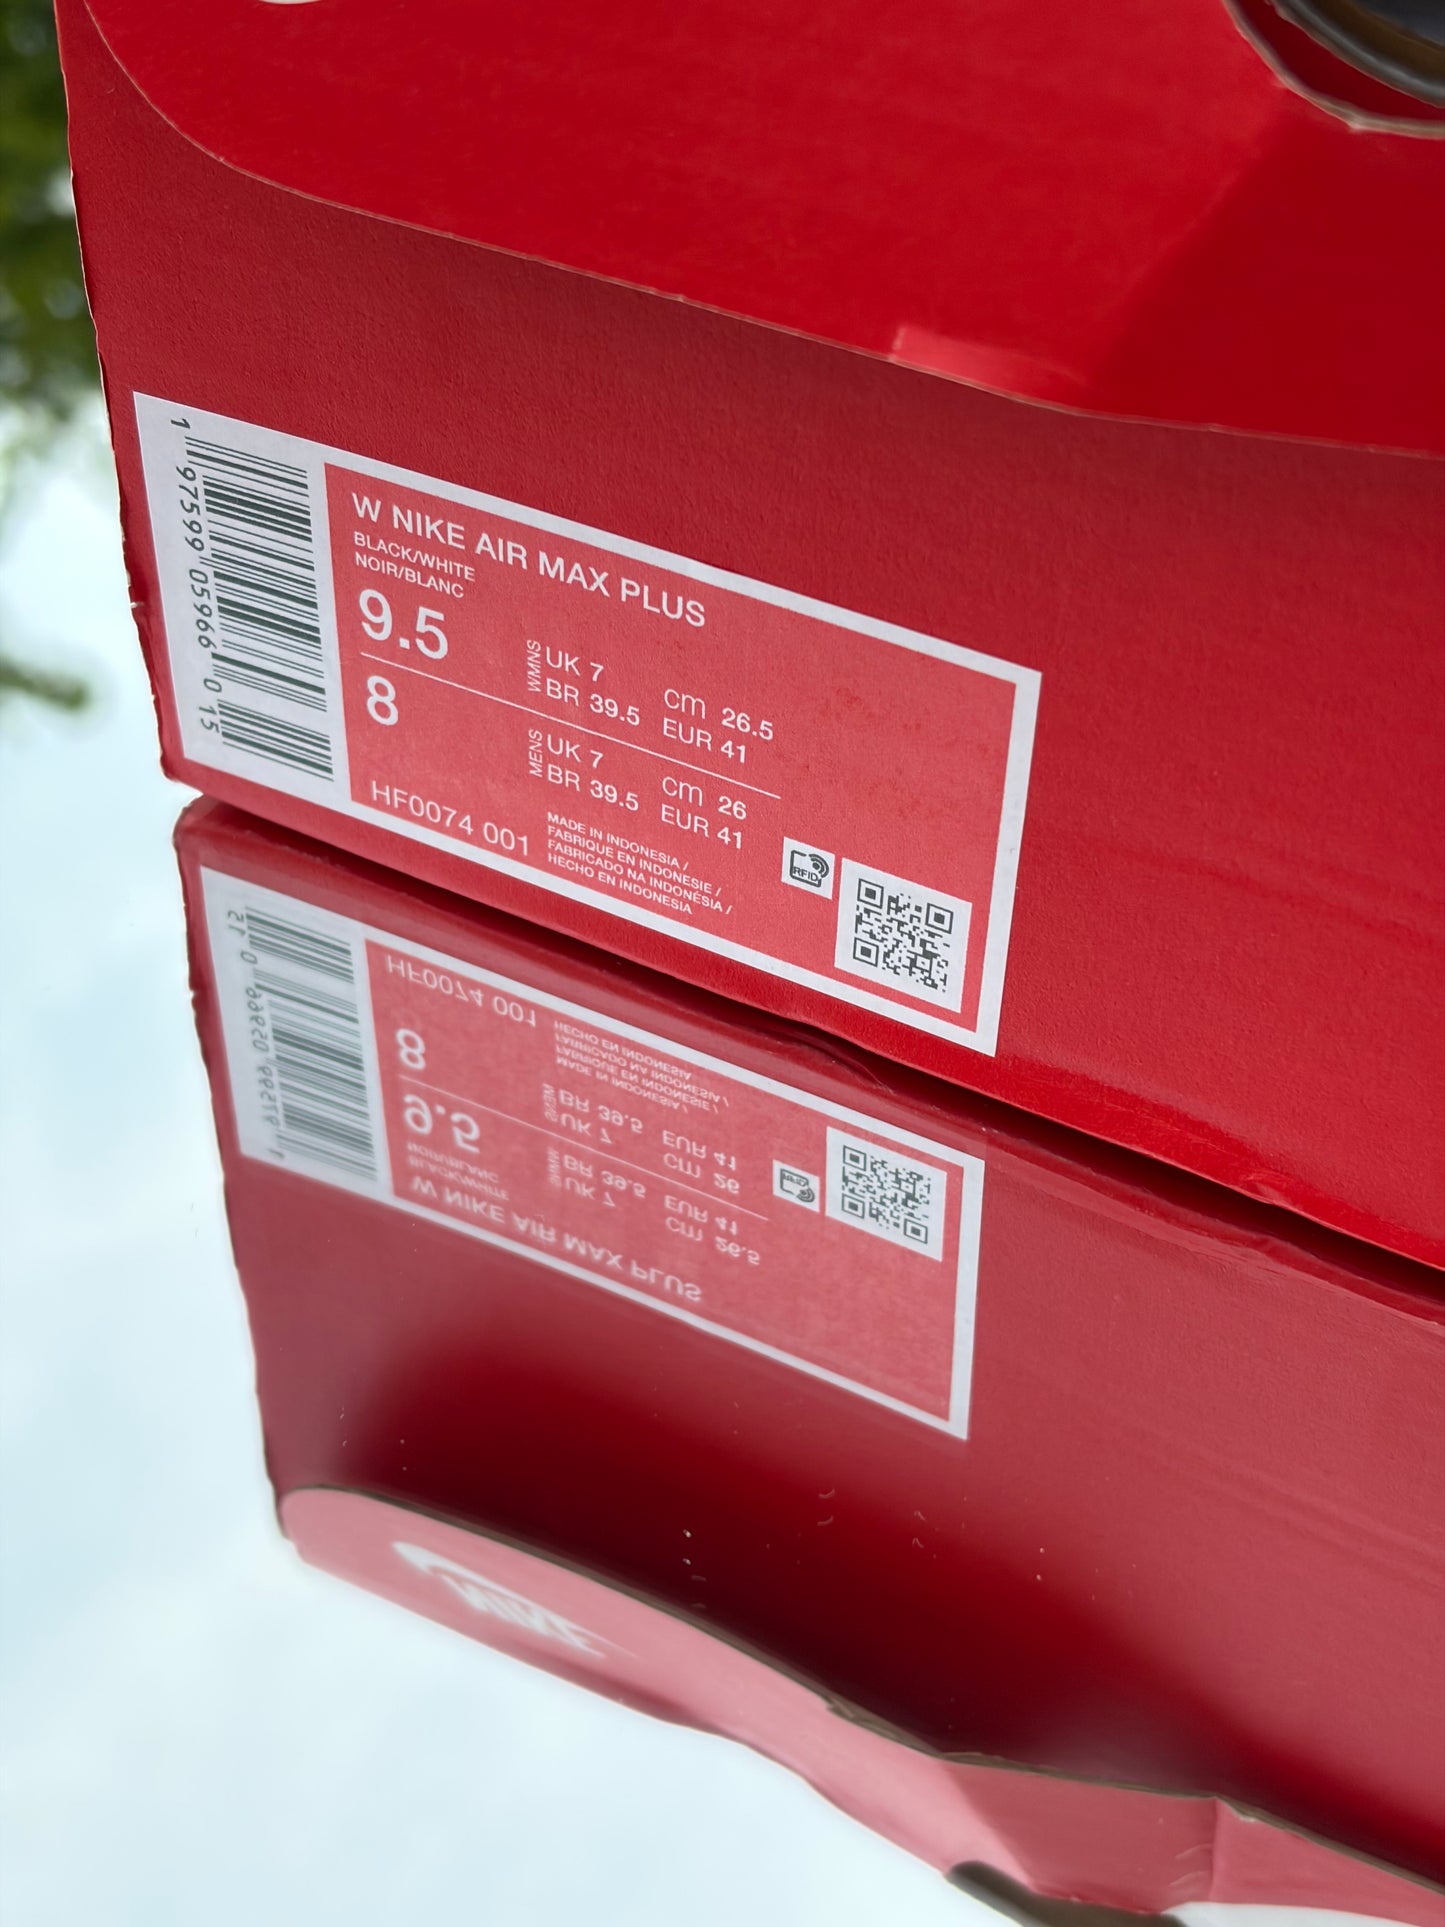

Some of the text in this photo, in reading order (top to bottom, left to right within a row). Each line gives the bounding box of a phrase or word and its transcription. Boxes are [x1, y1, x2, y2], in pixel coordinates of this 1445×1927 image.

[171, 418, 222, 733] 1 97599 05966 0 15
[352, 492, 705, 627] W NIKE AIR MAX PLUS
[354, 531, 475, 582] BLACK/WHITE
[355, 553, 464, 598] NOIR/BLANC
[359, 589, 448, 660] 9.5
[527, 640, 541, 693] WMNS
[546, 646, 604, 682] UK 7
[367, 675, 398, 726] 8
[546, 678, 640, 726] BR 39.5
[664, 689, 773, 740] cm 26.5
[529, 729, 543, 777] MENS
[547, 734, 603, 768] UK 7
[663, 718, 746, 763] EUR 41
[547, 764, 639, 811] BR 39.5
[662, 776, 747, 820] cm 26
[372, 781, 528, 856] HF0074 001
[547, 812, 586, 834] MADE
[590, 827, 603, 841] IN
[607, 832, 680, 868] INDONESIA
[661, 804, 742, 849] EUR 41
[547, 825, 614, 858] FABRIQUE
[617, 851, 635, 866] EN
[547, 839, 624, 875] FABRICADO
[627, 868, 645, 884] NA
[548, 854, 693, 914] HECHO EN INDONESIA
[793, 867, 818, 882] RFID
